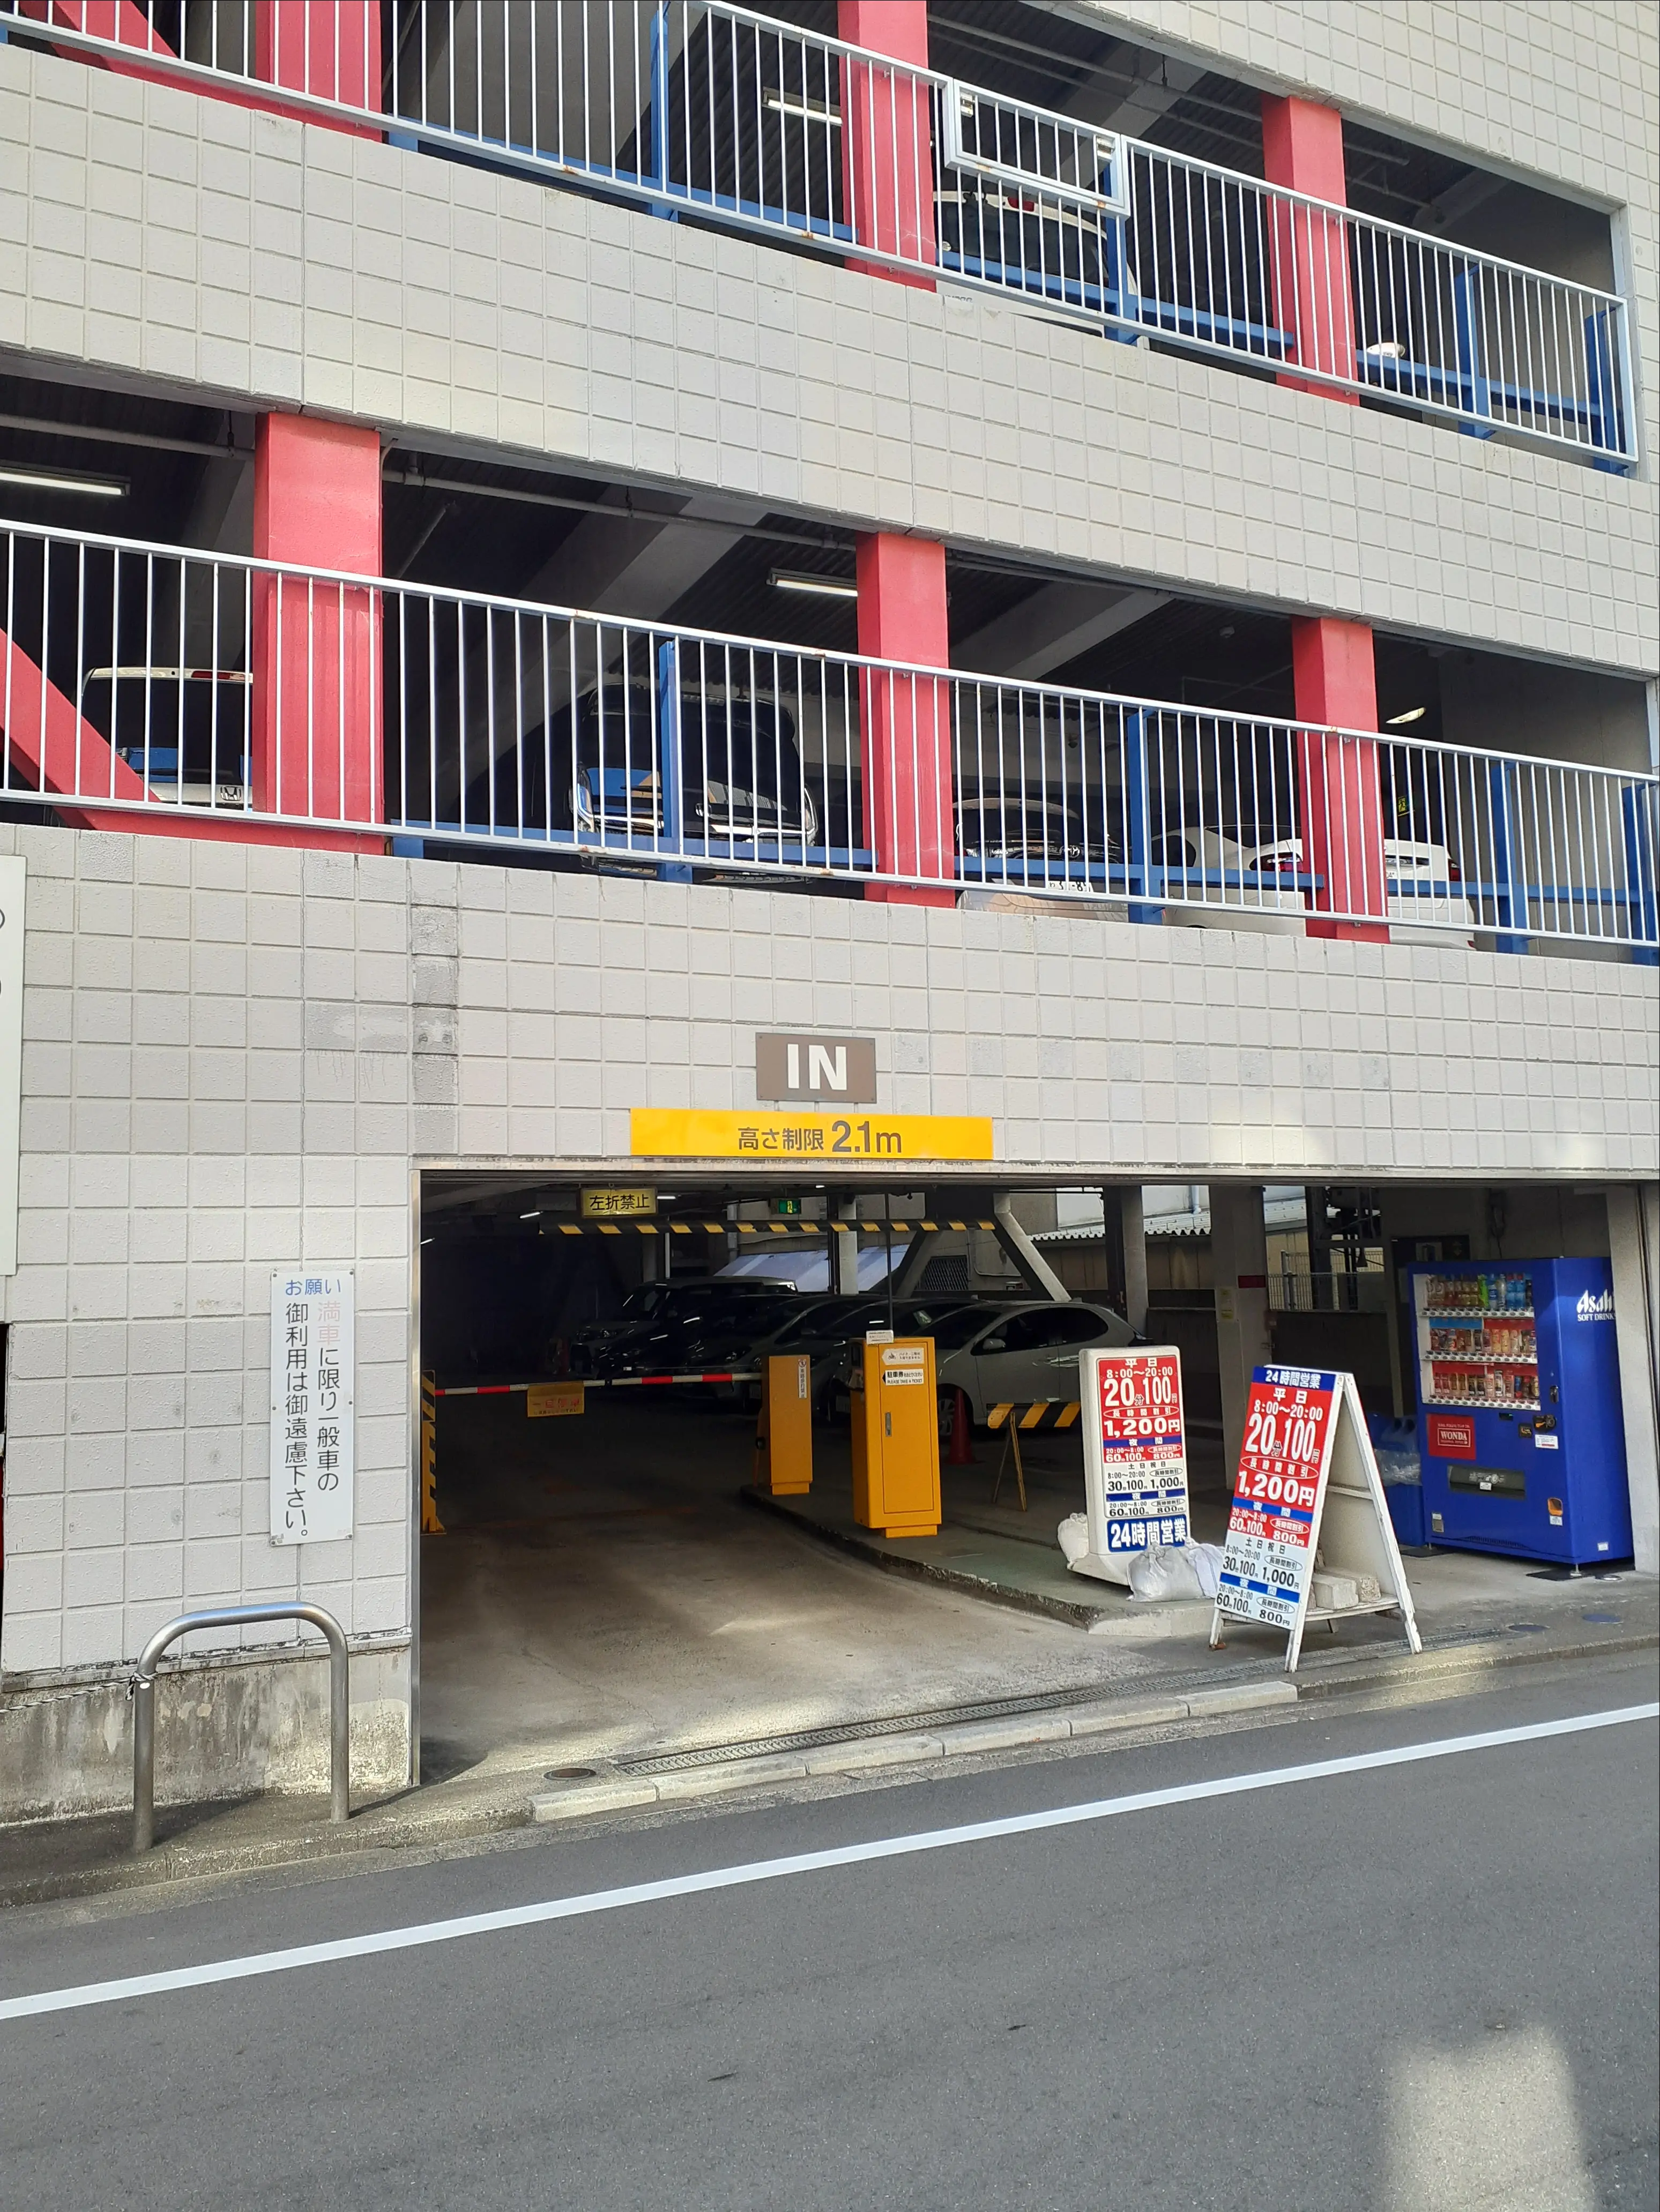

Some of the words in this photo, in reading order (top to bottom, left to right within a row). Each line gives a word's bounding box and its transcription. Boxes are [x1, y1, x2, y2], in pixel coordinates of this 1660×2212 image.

[787, 1043, 847, 1090] IN
[738, 1127, 824, 1150] 高さ制限
[831, 1120, 902, 1153] 2.1m
[590, 1193, 650, 1210] 左折禁止
[285, 1279, 341, 1295] お願い
[1577, 1314, 1594, 1322] SOFT
[1125, 1358, 1157, 1368] 平日
[1265, 1370, 1321, 1389] 24時間営業
[317, 1301, 341, 1492] 満車に限り一般車の
[1274, 1387, 1307, 1404] 平日
[285, 1302, 309, 1537] 御利用は御遠慮下さい。
[1104, 1417, 1180, 1438] 1,200円
[1440, 1431, 1467, 1440] WONDA
[1128, 1461, 1166, 1469] 土日祝日
[1238, 1470, 1315, 1507] 1,200円
[1111, 1518, 1186, 1548] 24時間営業
[1246, 1537, 1286, 1555] 土日祝日
[1262, 1567, 1300, 1589] 1,000円
[1260, 1609, 1290, 1626] 800円
